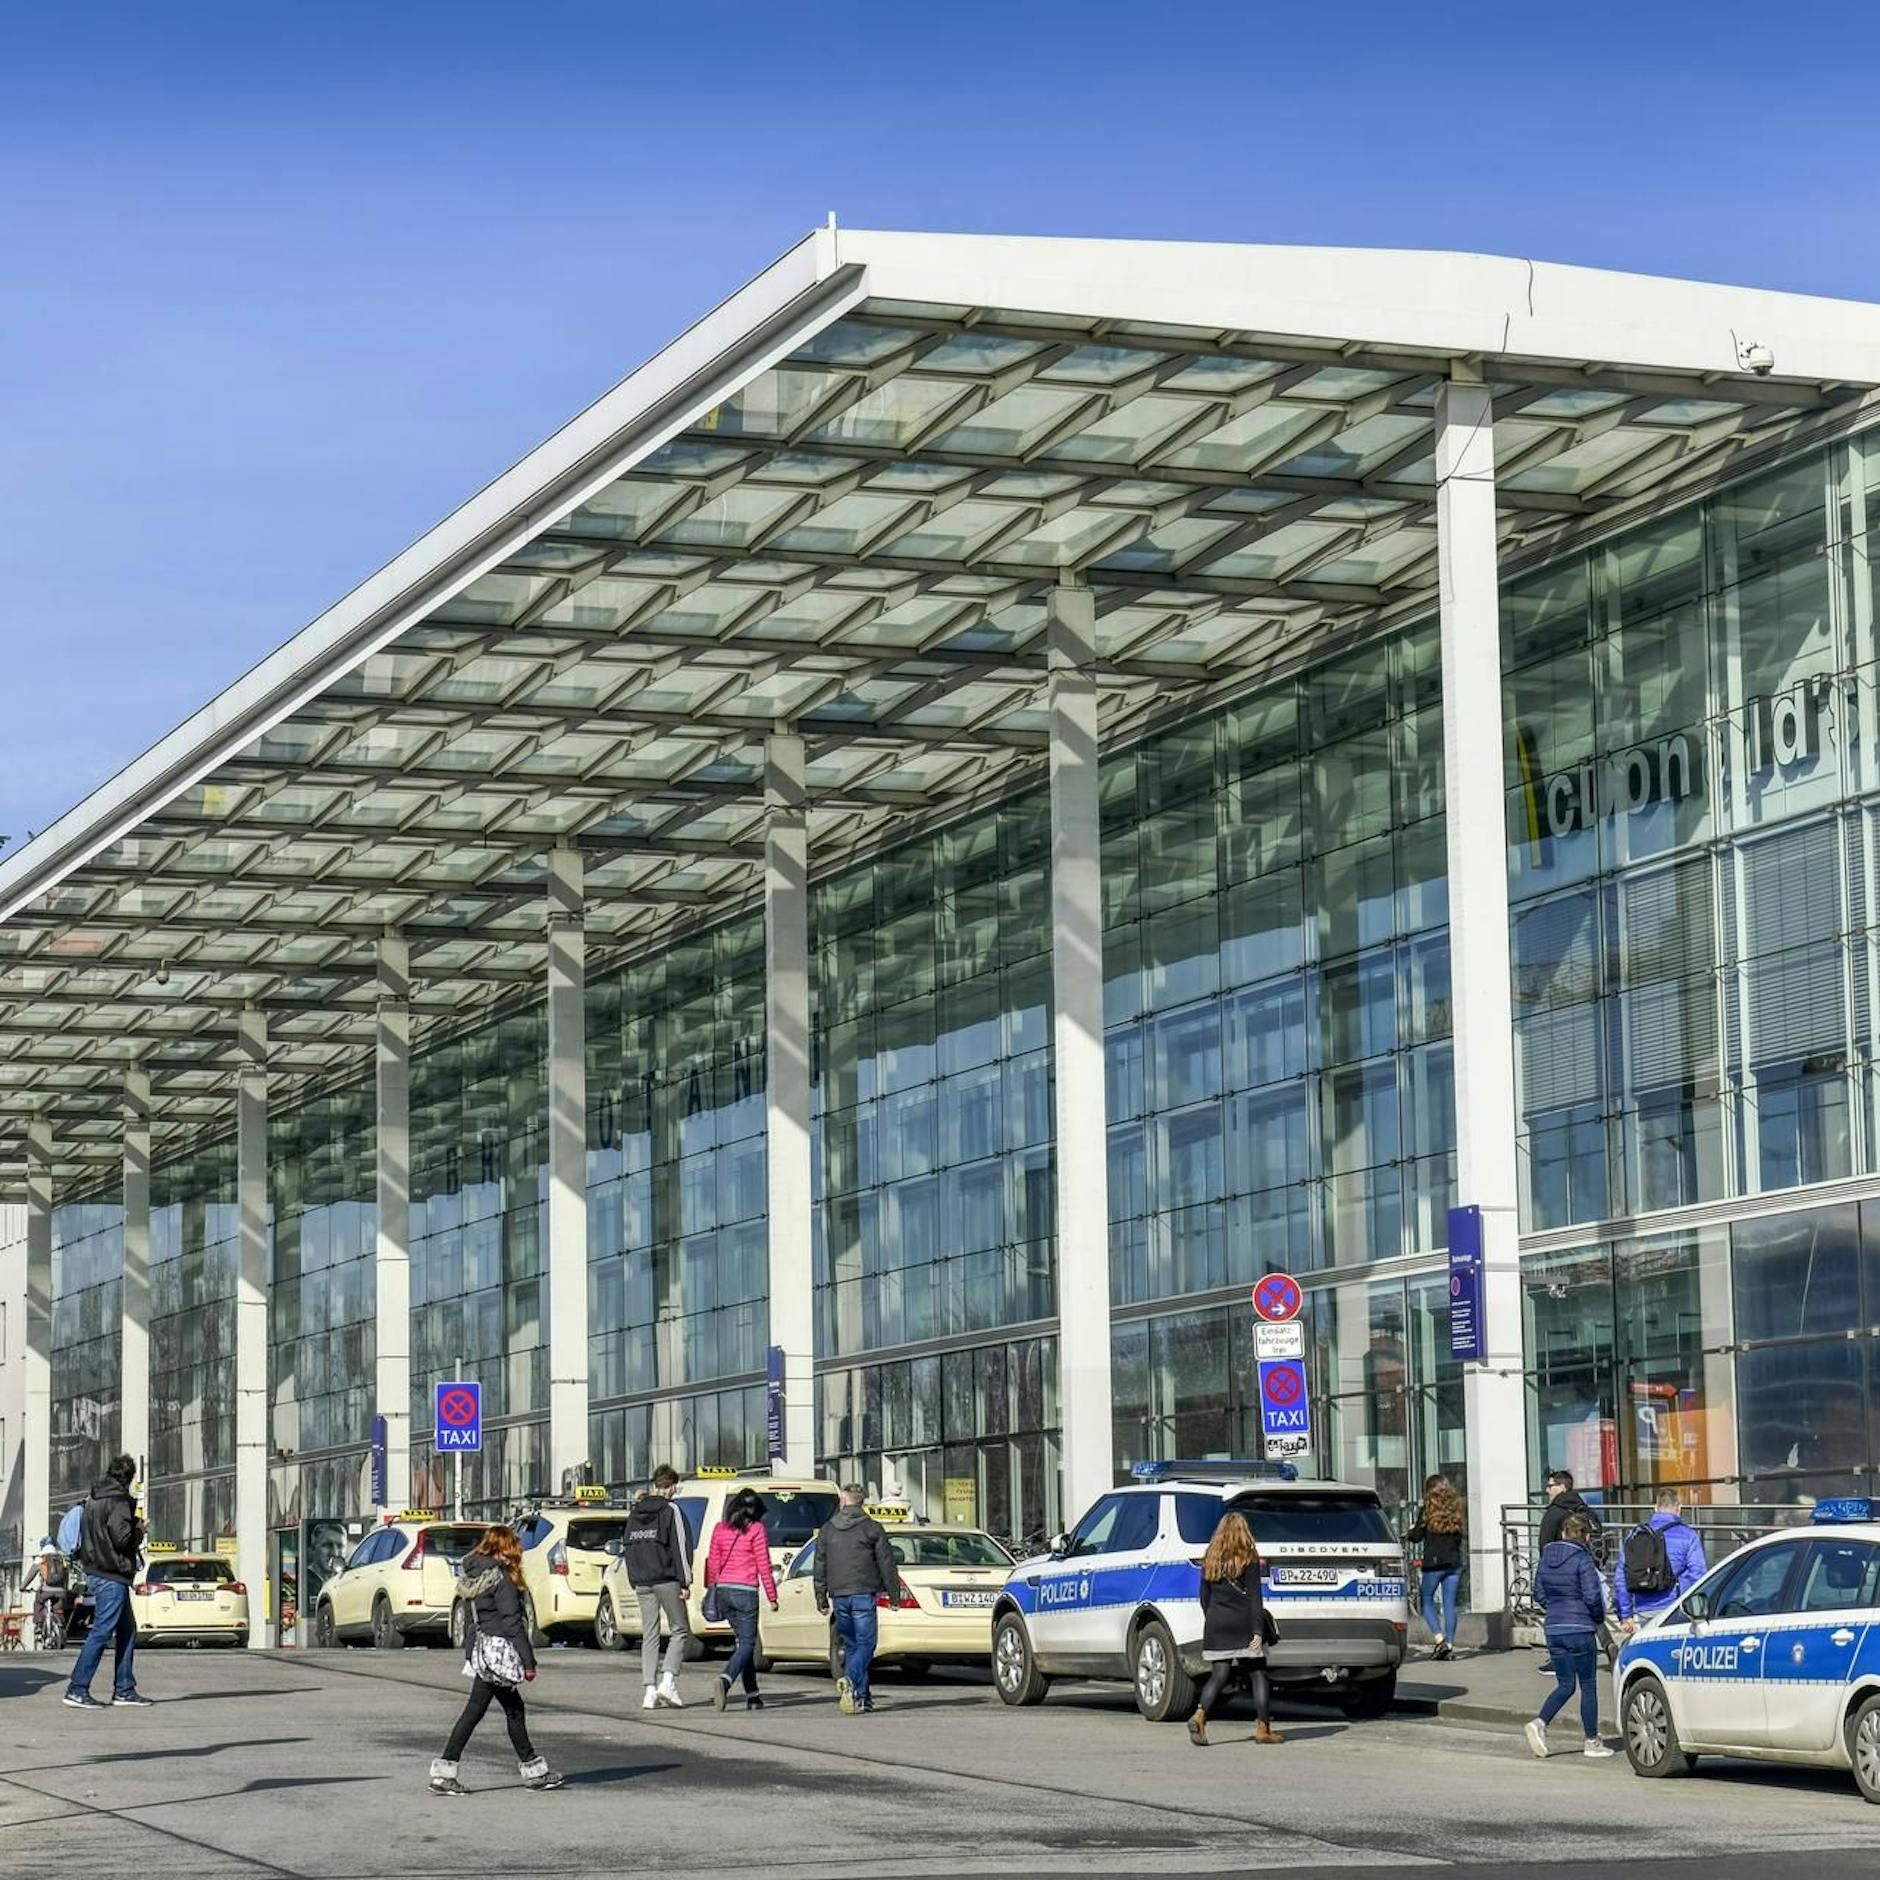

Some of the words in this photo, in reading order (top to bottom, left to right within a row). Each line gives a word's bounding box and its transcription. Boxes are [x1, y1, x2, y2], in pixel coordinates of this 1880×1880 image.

[1267, 1410, 1304, 1427] TAXI
[440, 1430, 476, 1445] TAXI
[580, 1488, 604, 1498] TAXI
[1040, 1580, 1078, 1605] POLIZEI
[1357, 1583, 1401, 1597] POLIZEI
[1682, 1645, 1739, 1670] POLIZEI
